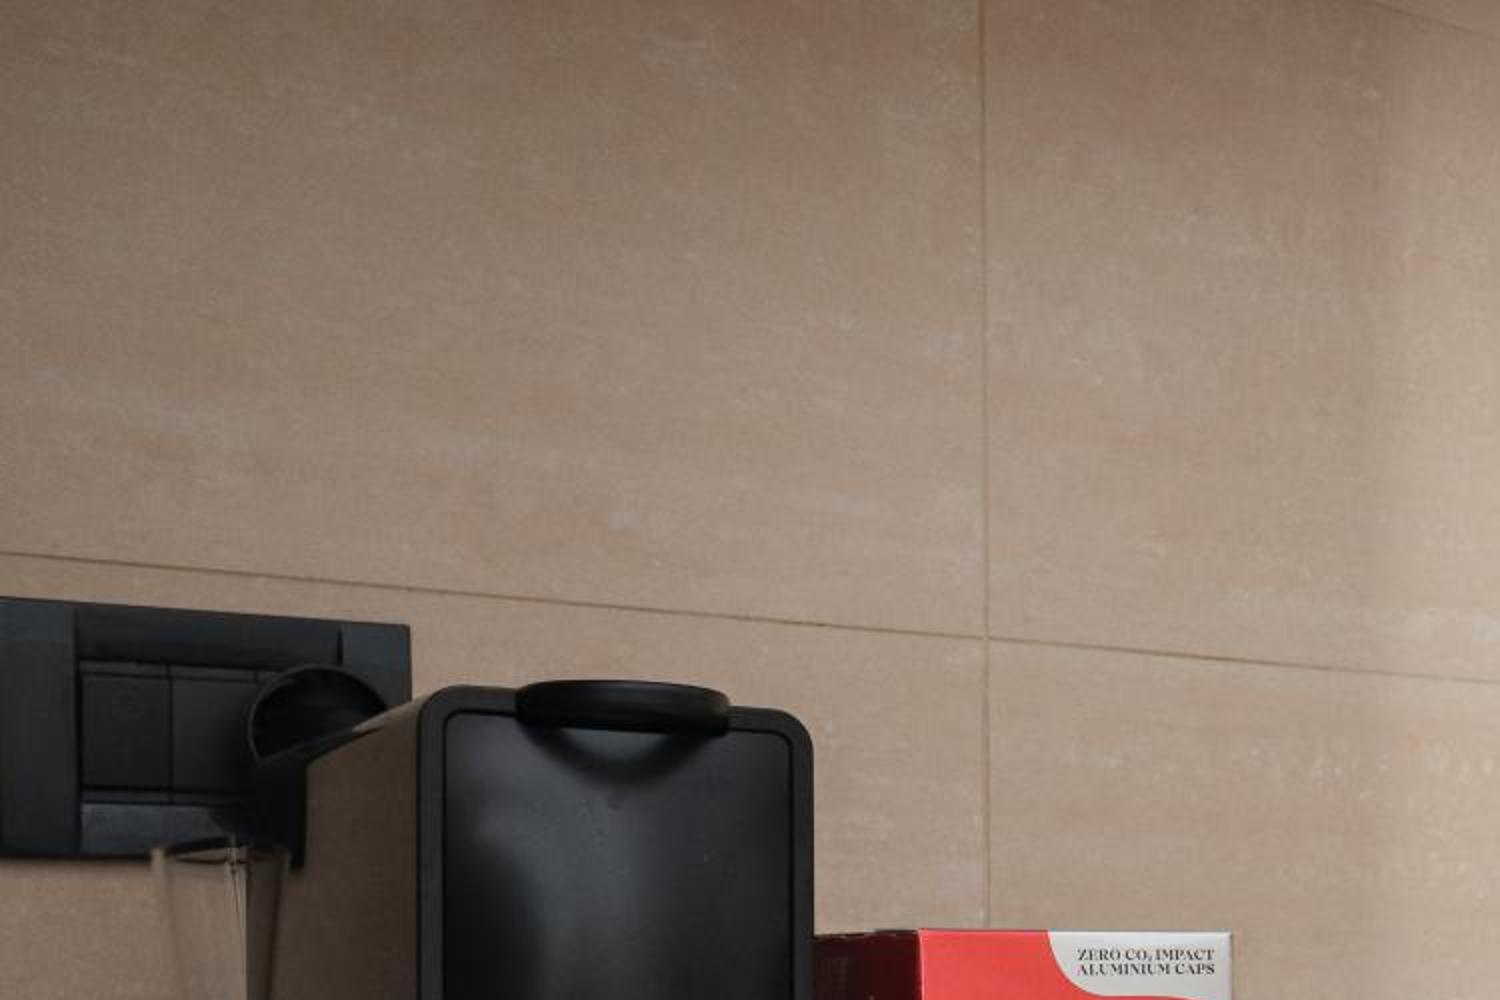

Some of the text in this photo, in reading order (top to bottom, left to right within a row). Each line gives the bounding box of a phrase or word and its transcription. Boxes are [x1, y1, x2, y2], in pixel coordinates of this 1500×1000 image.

[1077, 948, 1121, 962] ZERO
[1155, 948, 1215, 962] IMPACT
[1077, 962, 1215, 976] ALUMINIUM CAPS
